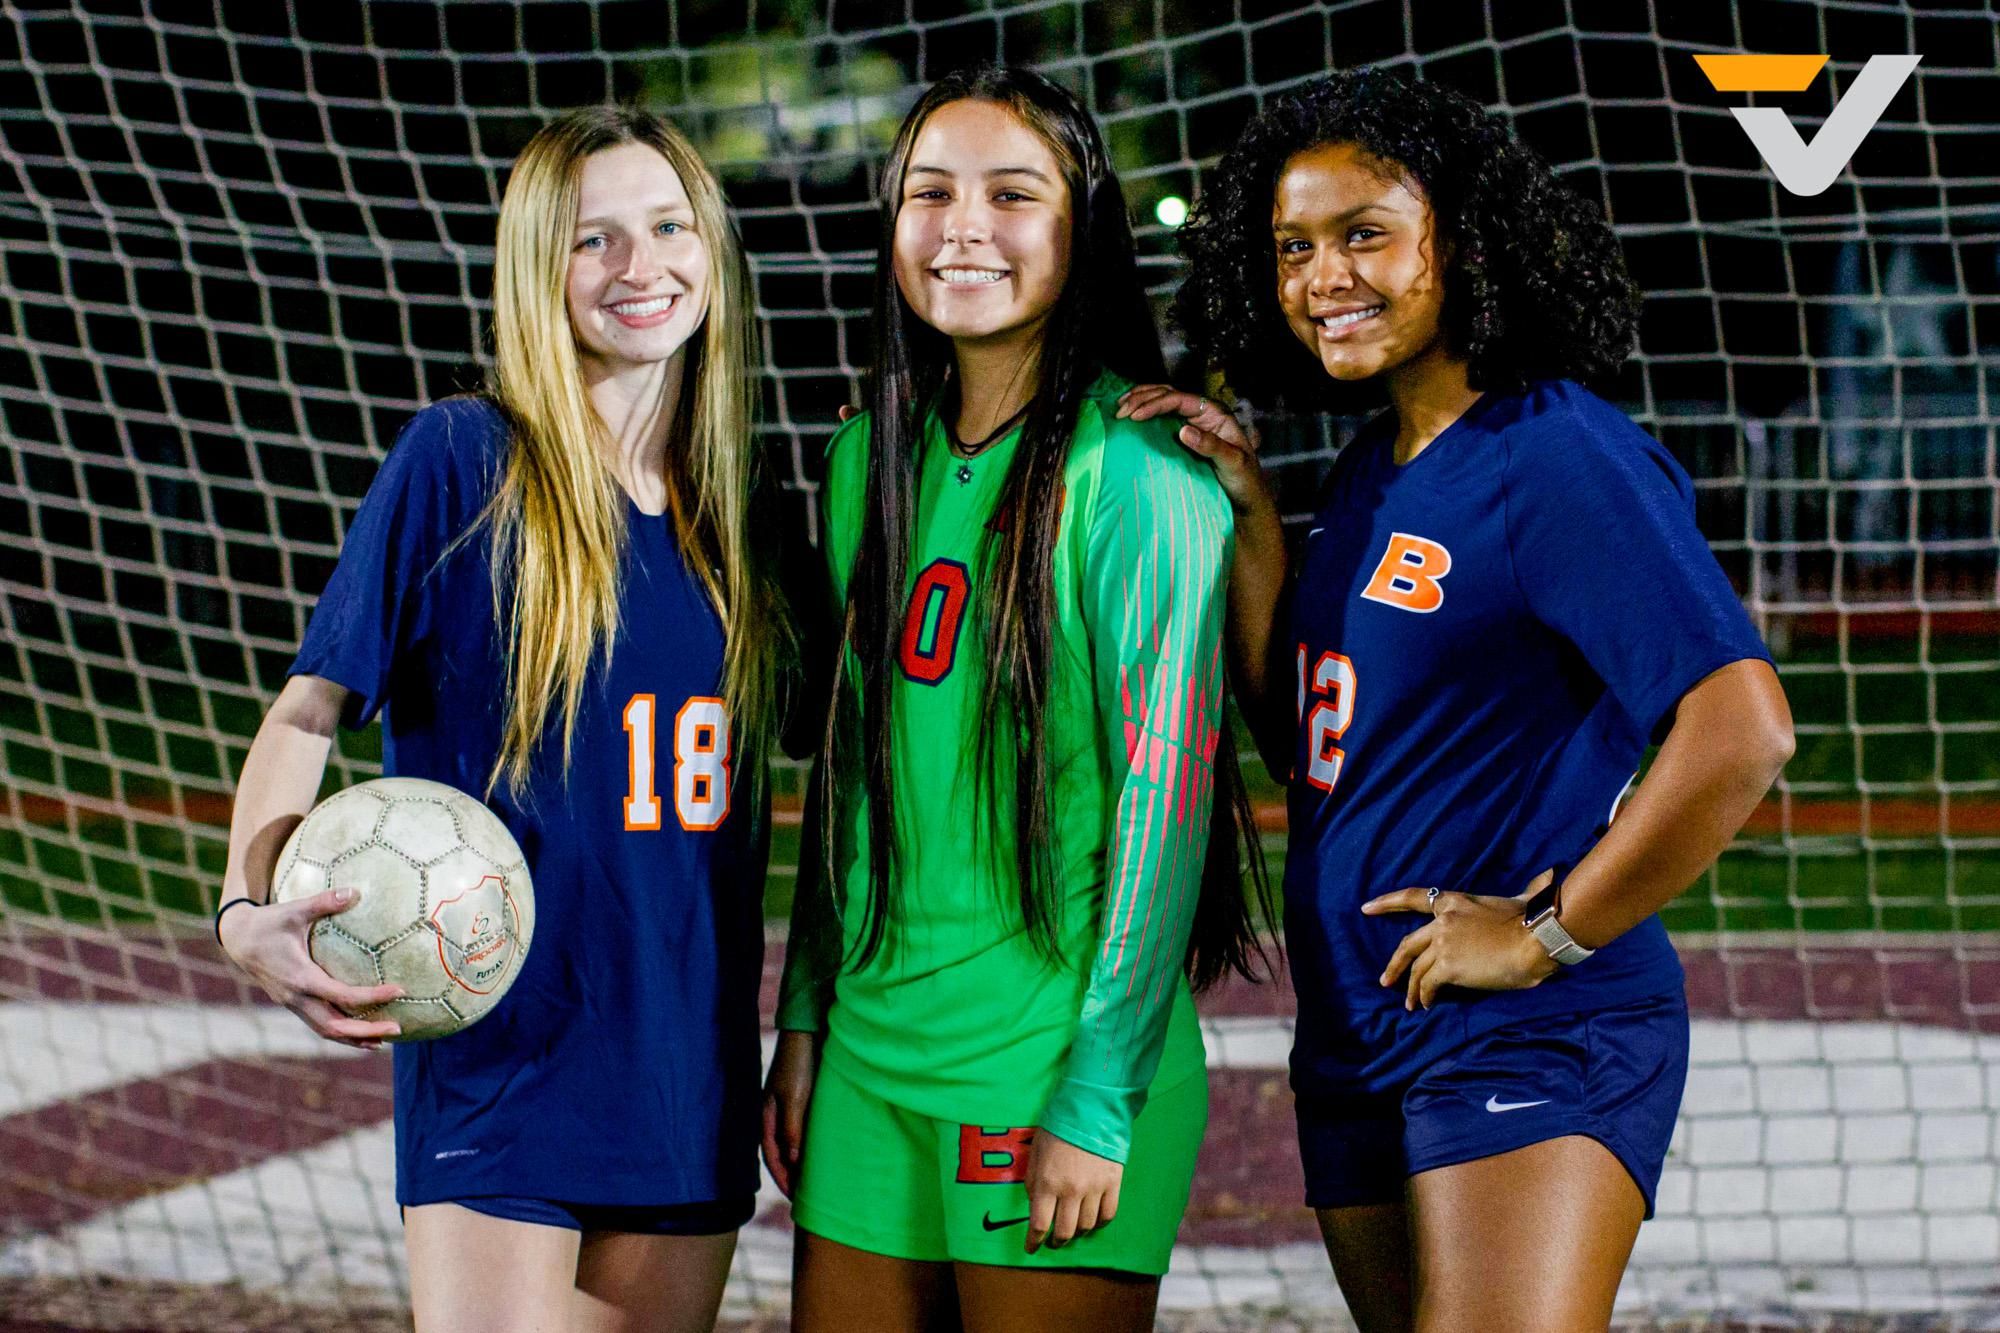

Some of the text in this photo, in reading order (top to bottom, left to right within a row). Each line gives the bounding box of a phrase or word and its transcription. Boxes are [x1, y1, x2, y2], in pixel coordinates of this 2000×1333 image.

[900, 556, 972, 687] 0
[1360, 532, 1452, 613] B
[622, 693, 732, 831] 18
[956, 1123, 1040, 1184] B
